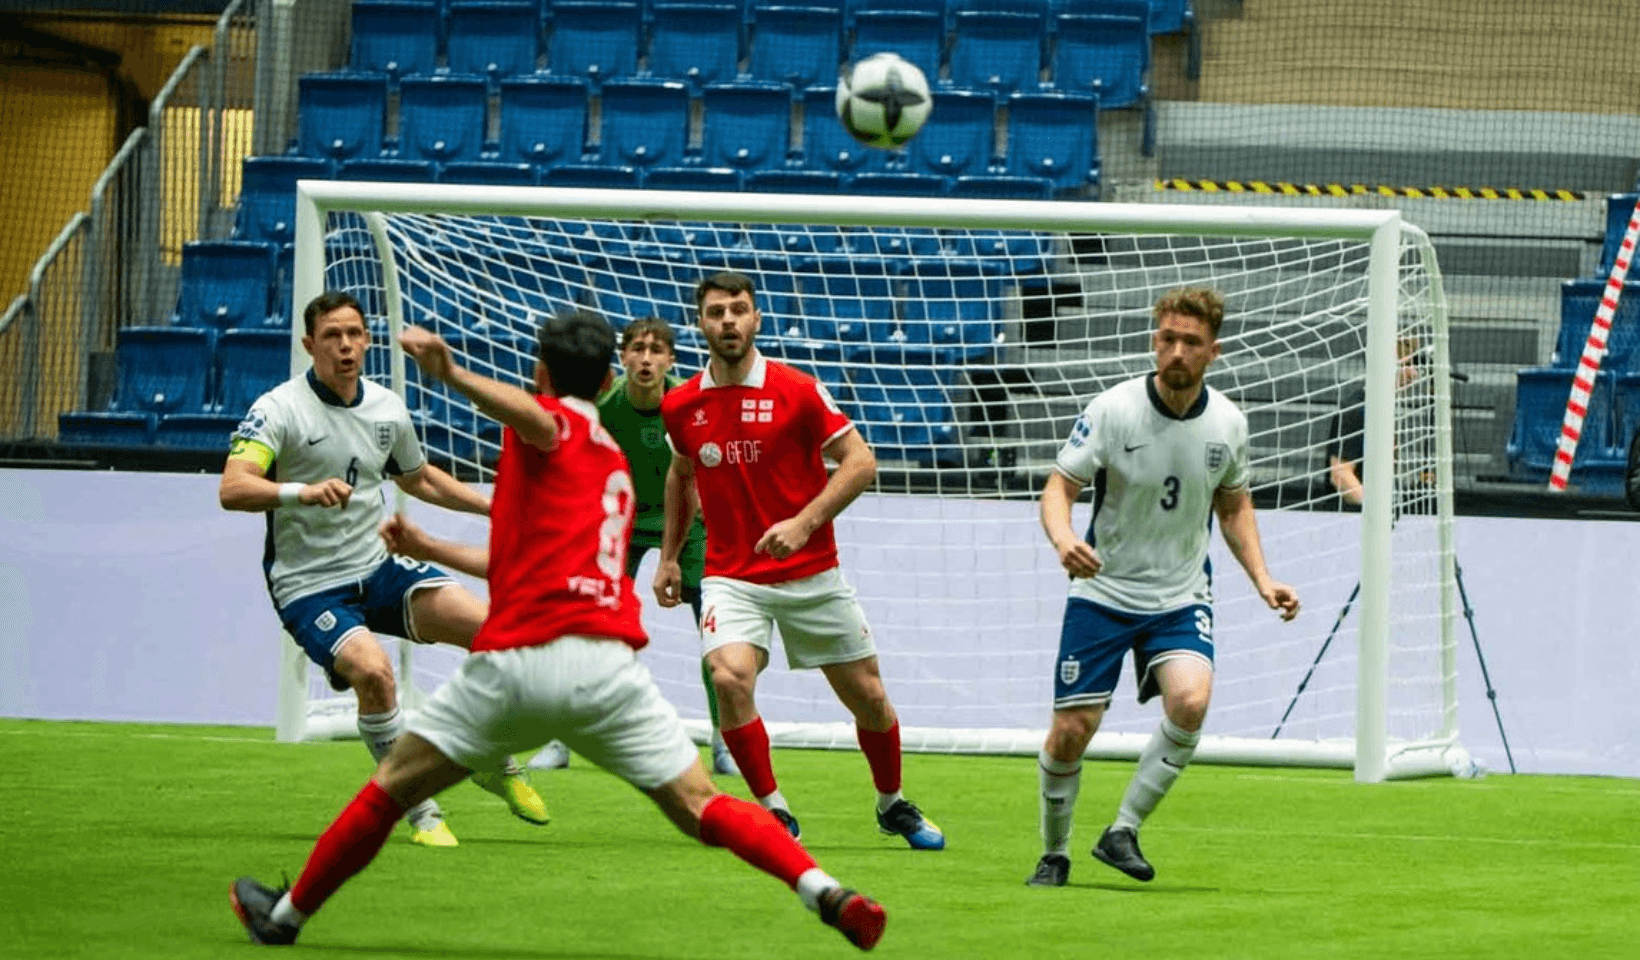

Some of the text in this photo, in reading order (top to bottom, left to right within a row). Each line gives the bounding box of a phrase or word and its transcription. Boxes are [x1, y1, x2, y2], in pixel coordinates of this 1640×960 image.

[726, 440, 762, 464] GFDF
[1160, 475, 1181, 511] 3
[596, 470, 634, 581] 8
